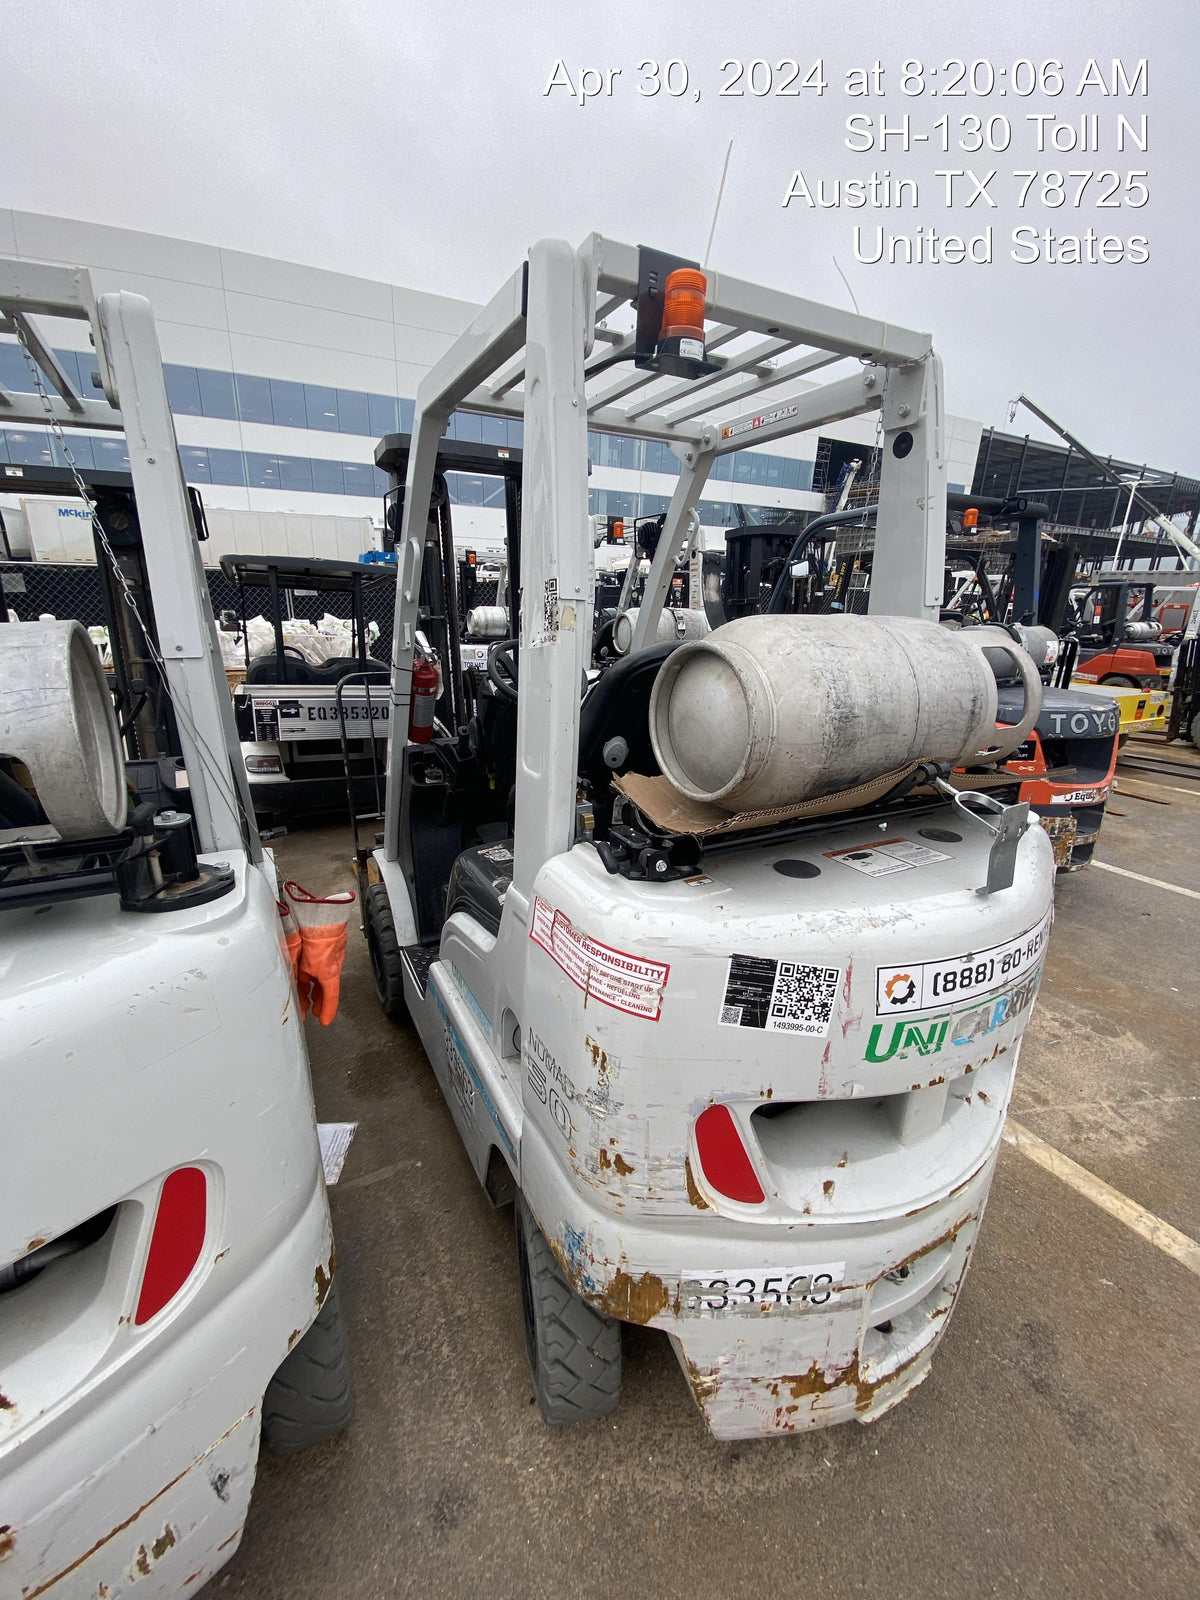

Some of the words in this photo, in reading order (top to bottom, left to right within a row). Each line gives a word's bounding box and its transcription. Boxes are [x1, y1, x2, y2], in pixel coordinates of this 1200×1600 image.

[553, 914, 582, 946] CUSTOMER
[581, 940, 664, 980] RESPONSIBILITY
[622, 979, 642, 991] START
[643, 984, 654, 993] UP
[933, 958, 994, 996] (888)
[580, 976, 617, 1002] MANTENANCE
[620, 999, 654, 1014] CLEANING
[606, 982, 641, 1001] REFUELING
[772, 1021, 824, 1035] 1493995-00-C
